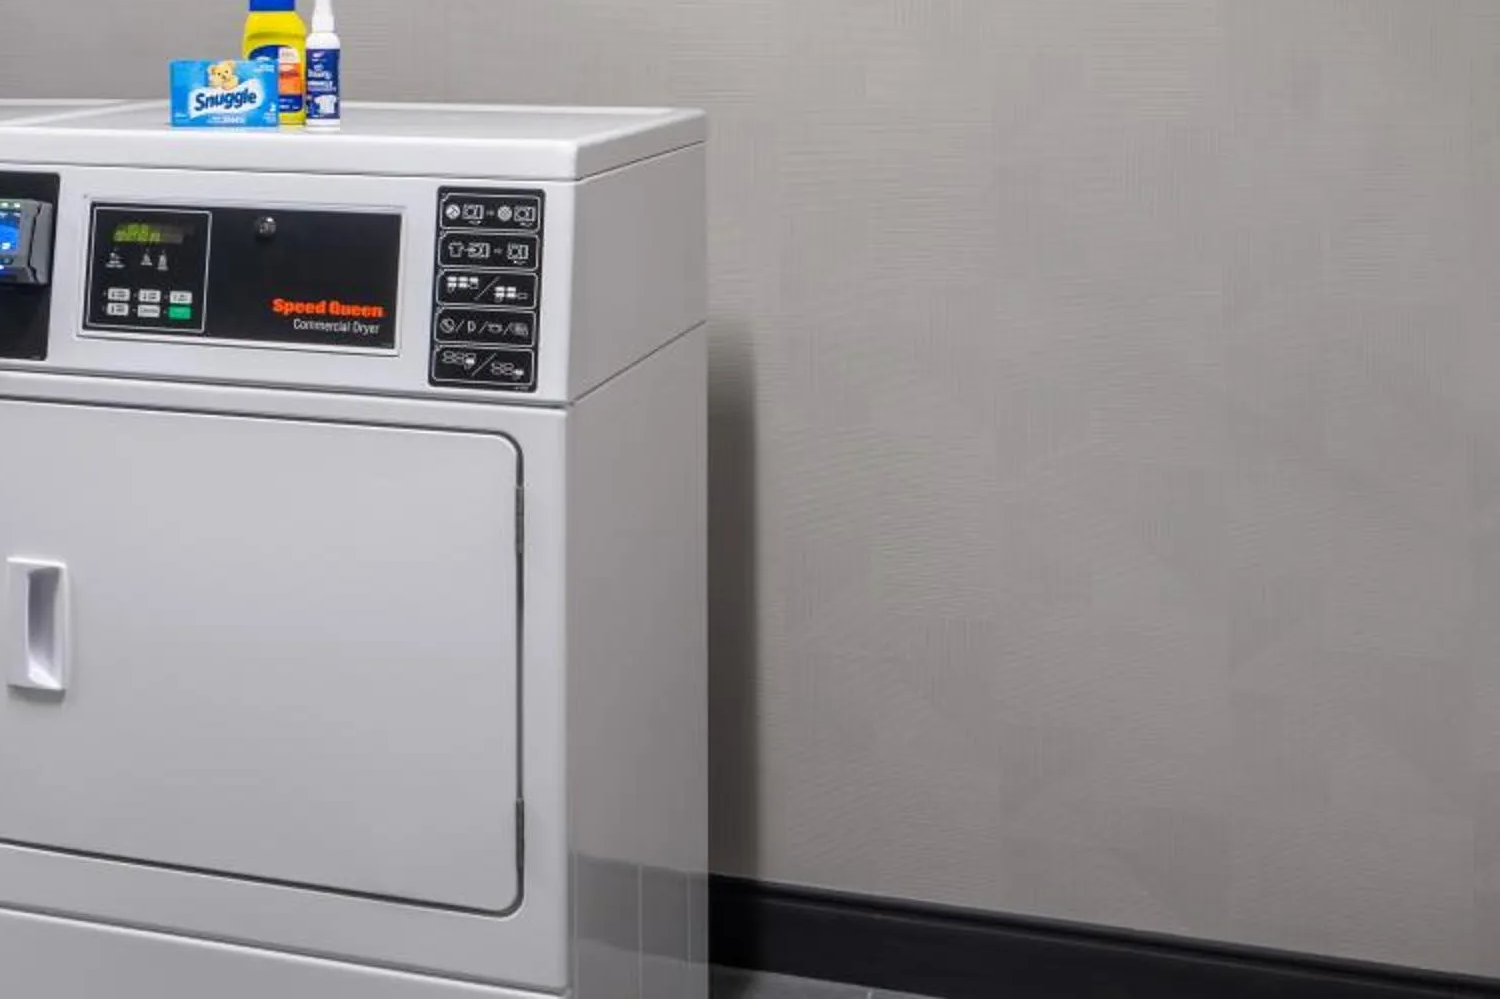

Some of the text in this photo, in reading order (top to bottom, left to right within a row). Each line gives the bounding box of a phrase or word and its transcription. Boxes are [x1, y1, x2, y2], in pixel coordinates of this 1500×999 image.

[194, 88, 257, 111] Snuggle
[272, 298, 384, 318] Speed Queen
[293, 318, 381, 336] Commercial Dryer
